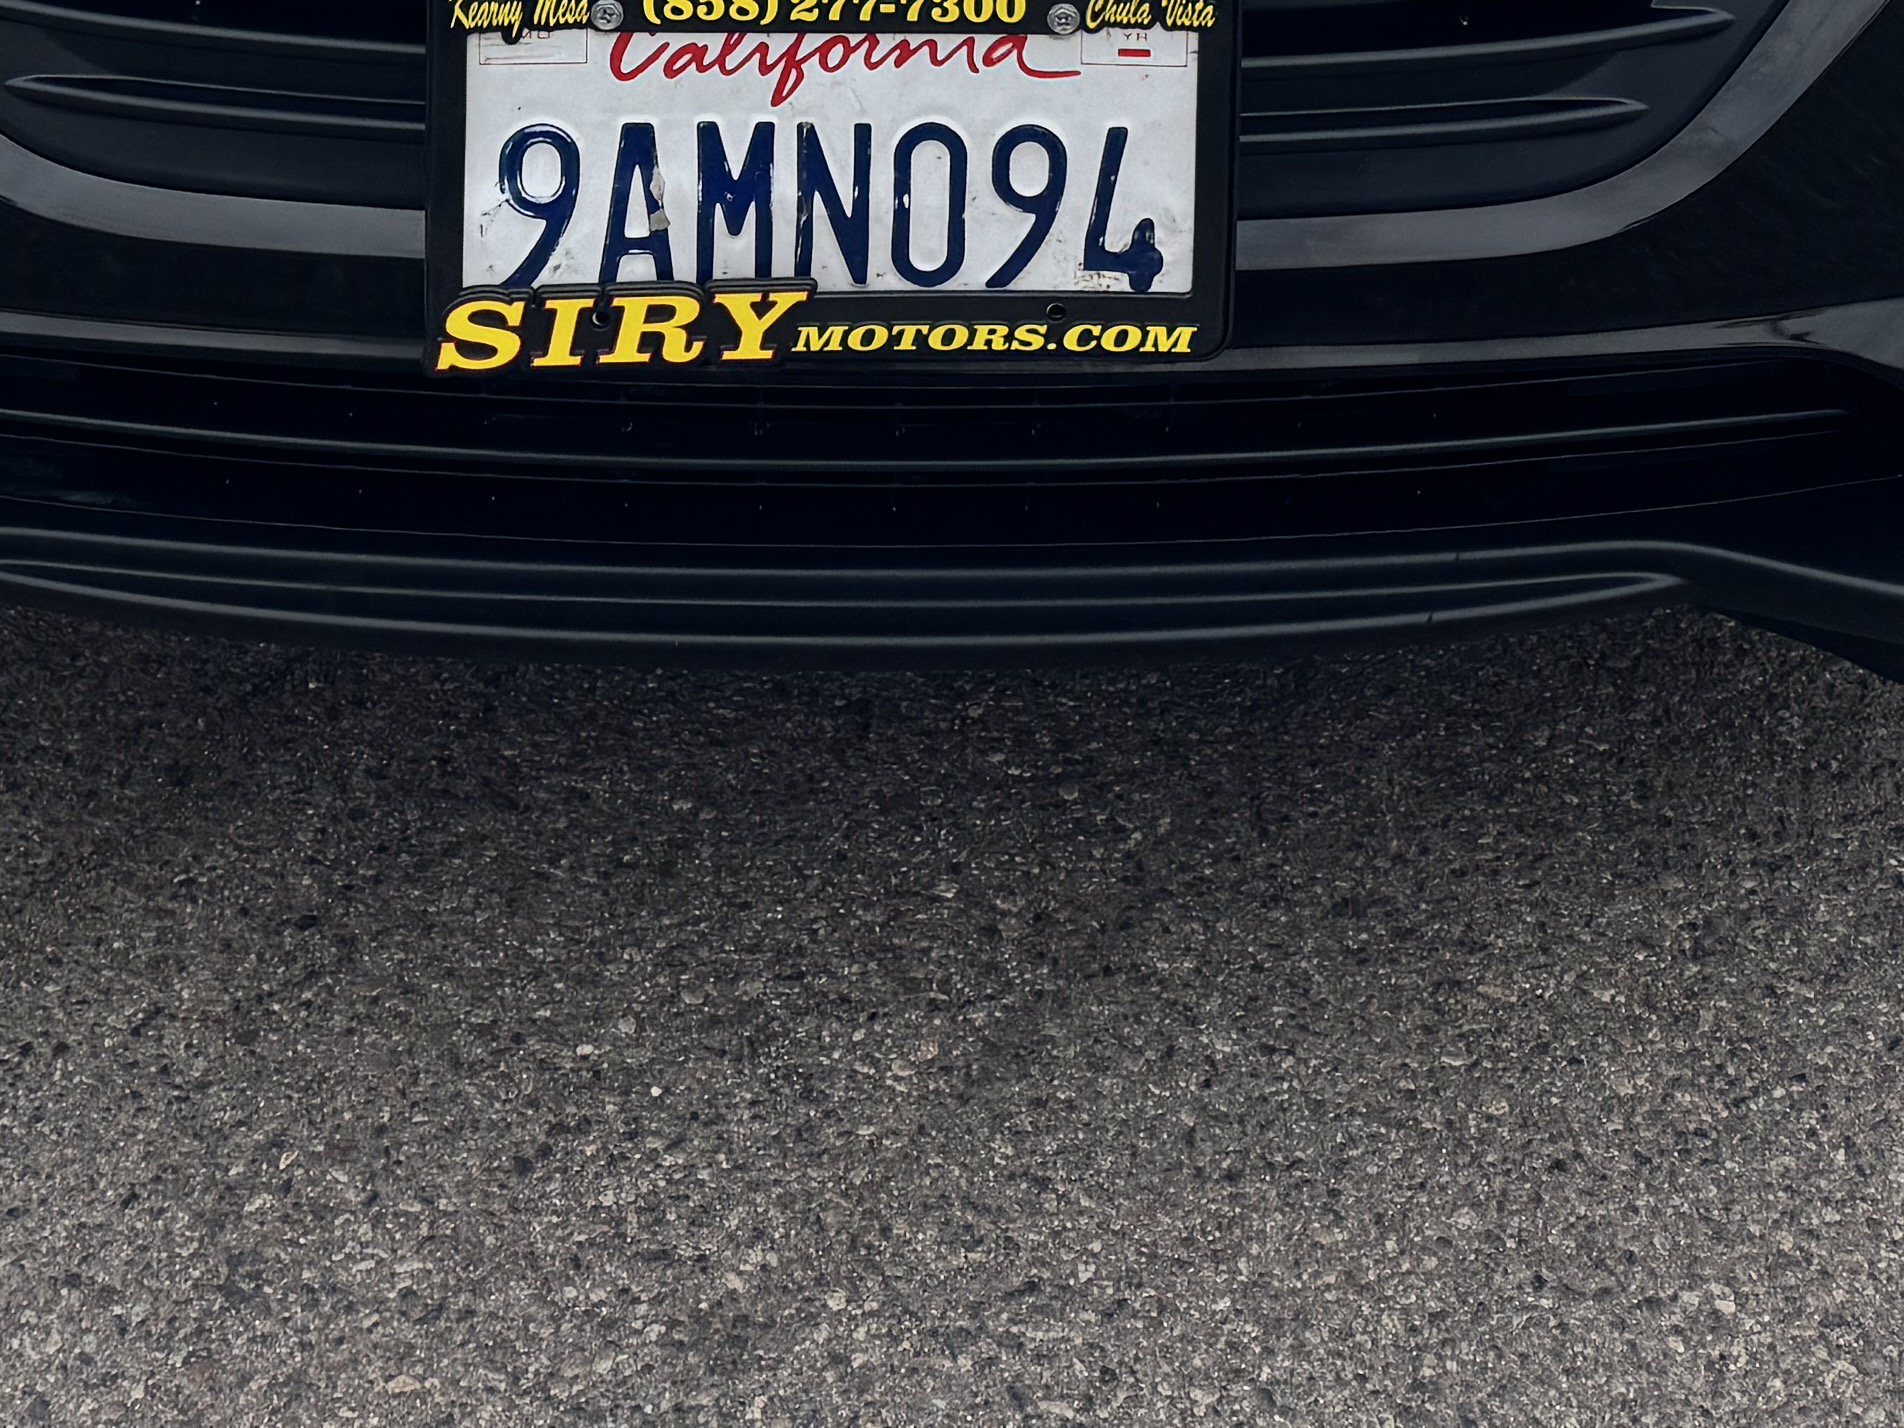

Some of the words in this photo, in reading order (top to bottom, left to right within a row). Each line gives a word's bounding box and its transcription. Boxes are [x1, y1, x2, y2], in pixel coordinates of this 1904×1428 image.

[609, 31, 1081, 107] California
[499, 121, 1164, 293] 9AMN094
[434, 291, 809, 372] SIRY
[791, 325, 1198, 353] MOTORS.COM
